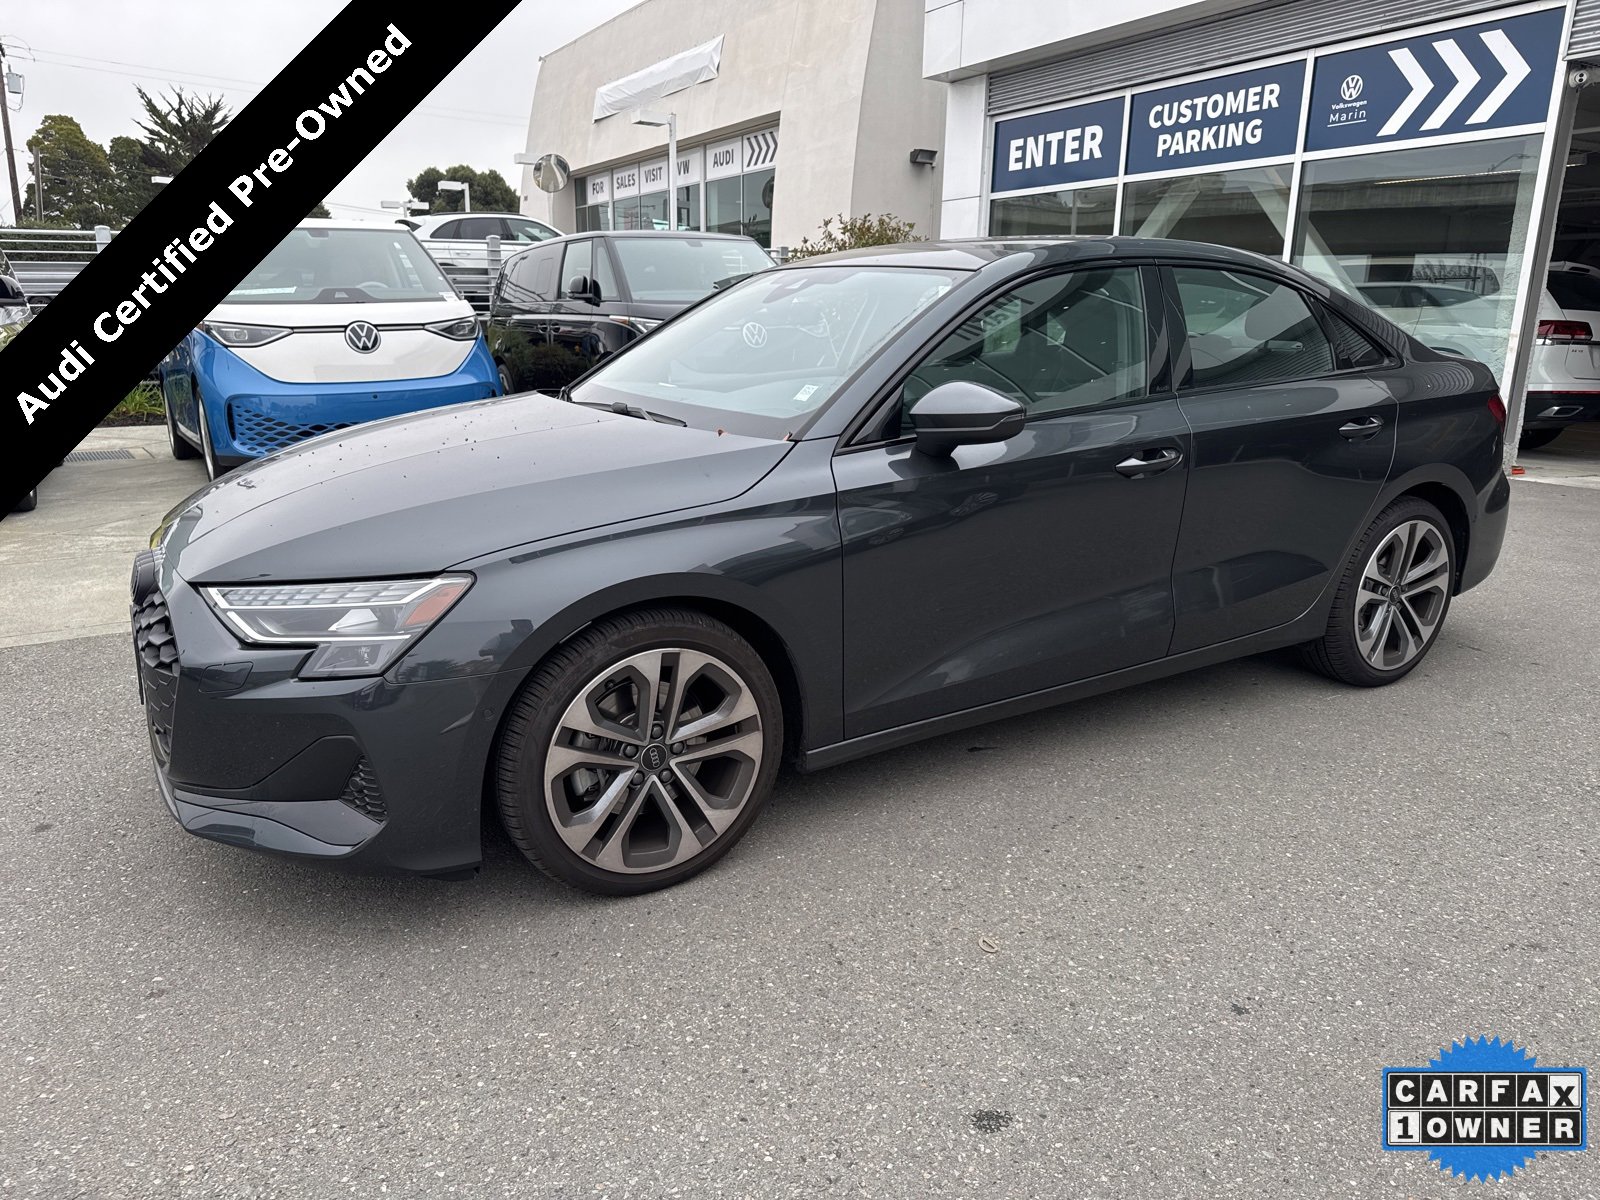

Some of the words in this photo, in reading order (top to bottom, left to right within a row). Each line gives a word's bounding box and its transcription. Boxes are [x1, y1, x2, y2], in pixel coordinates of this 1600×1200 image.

[1148, 83, 1280, 129] CUSTOMER
[1329, 109, 1367, 123] Marin
[1331, 100, 1368, 110] Volkswagen
[1008, 124, 1104, 172] ENTER
[1156, 118, 1263, 158] PARKING
[592, 180, 605, 196] FOR
[616, 173, 636, 190] SALES
[644, 166, 663, 184] VISIT
[676, 159, 690, 176] VW
[712, 148, 734, 169] AUDI
